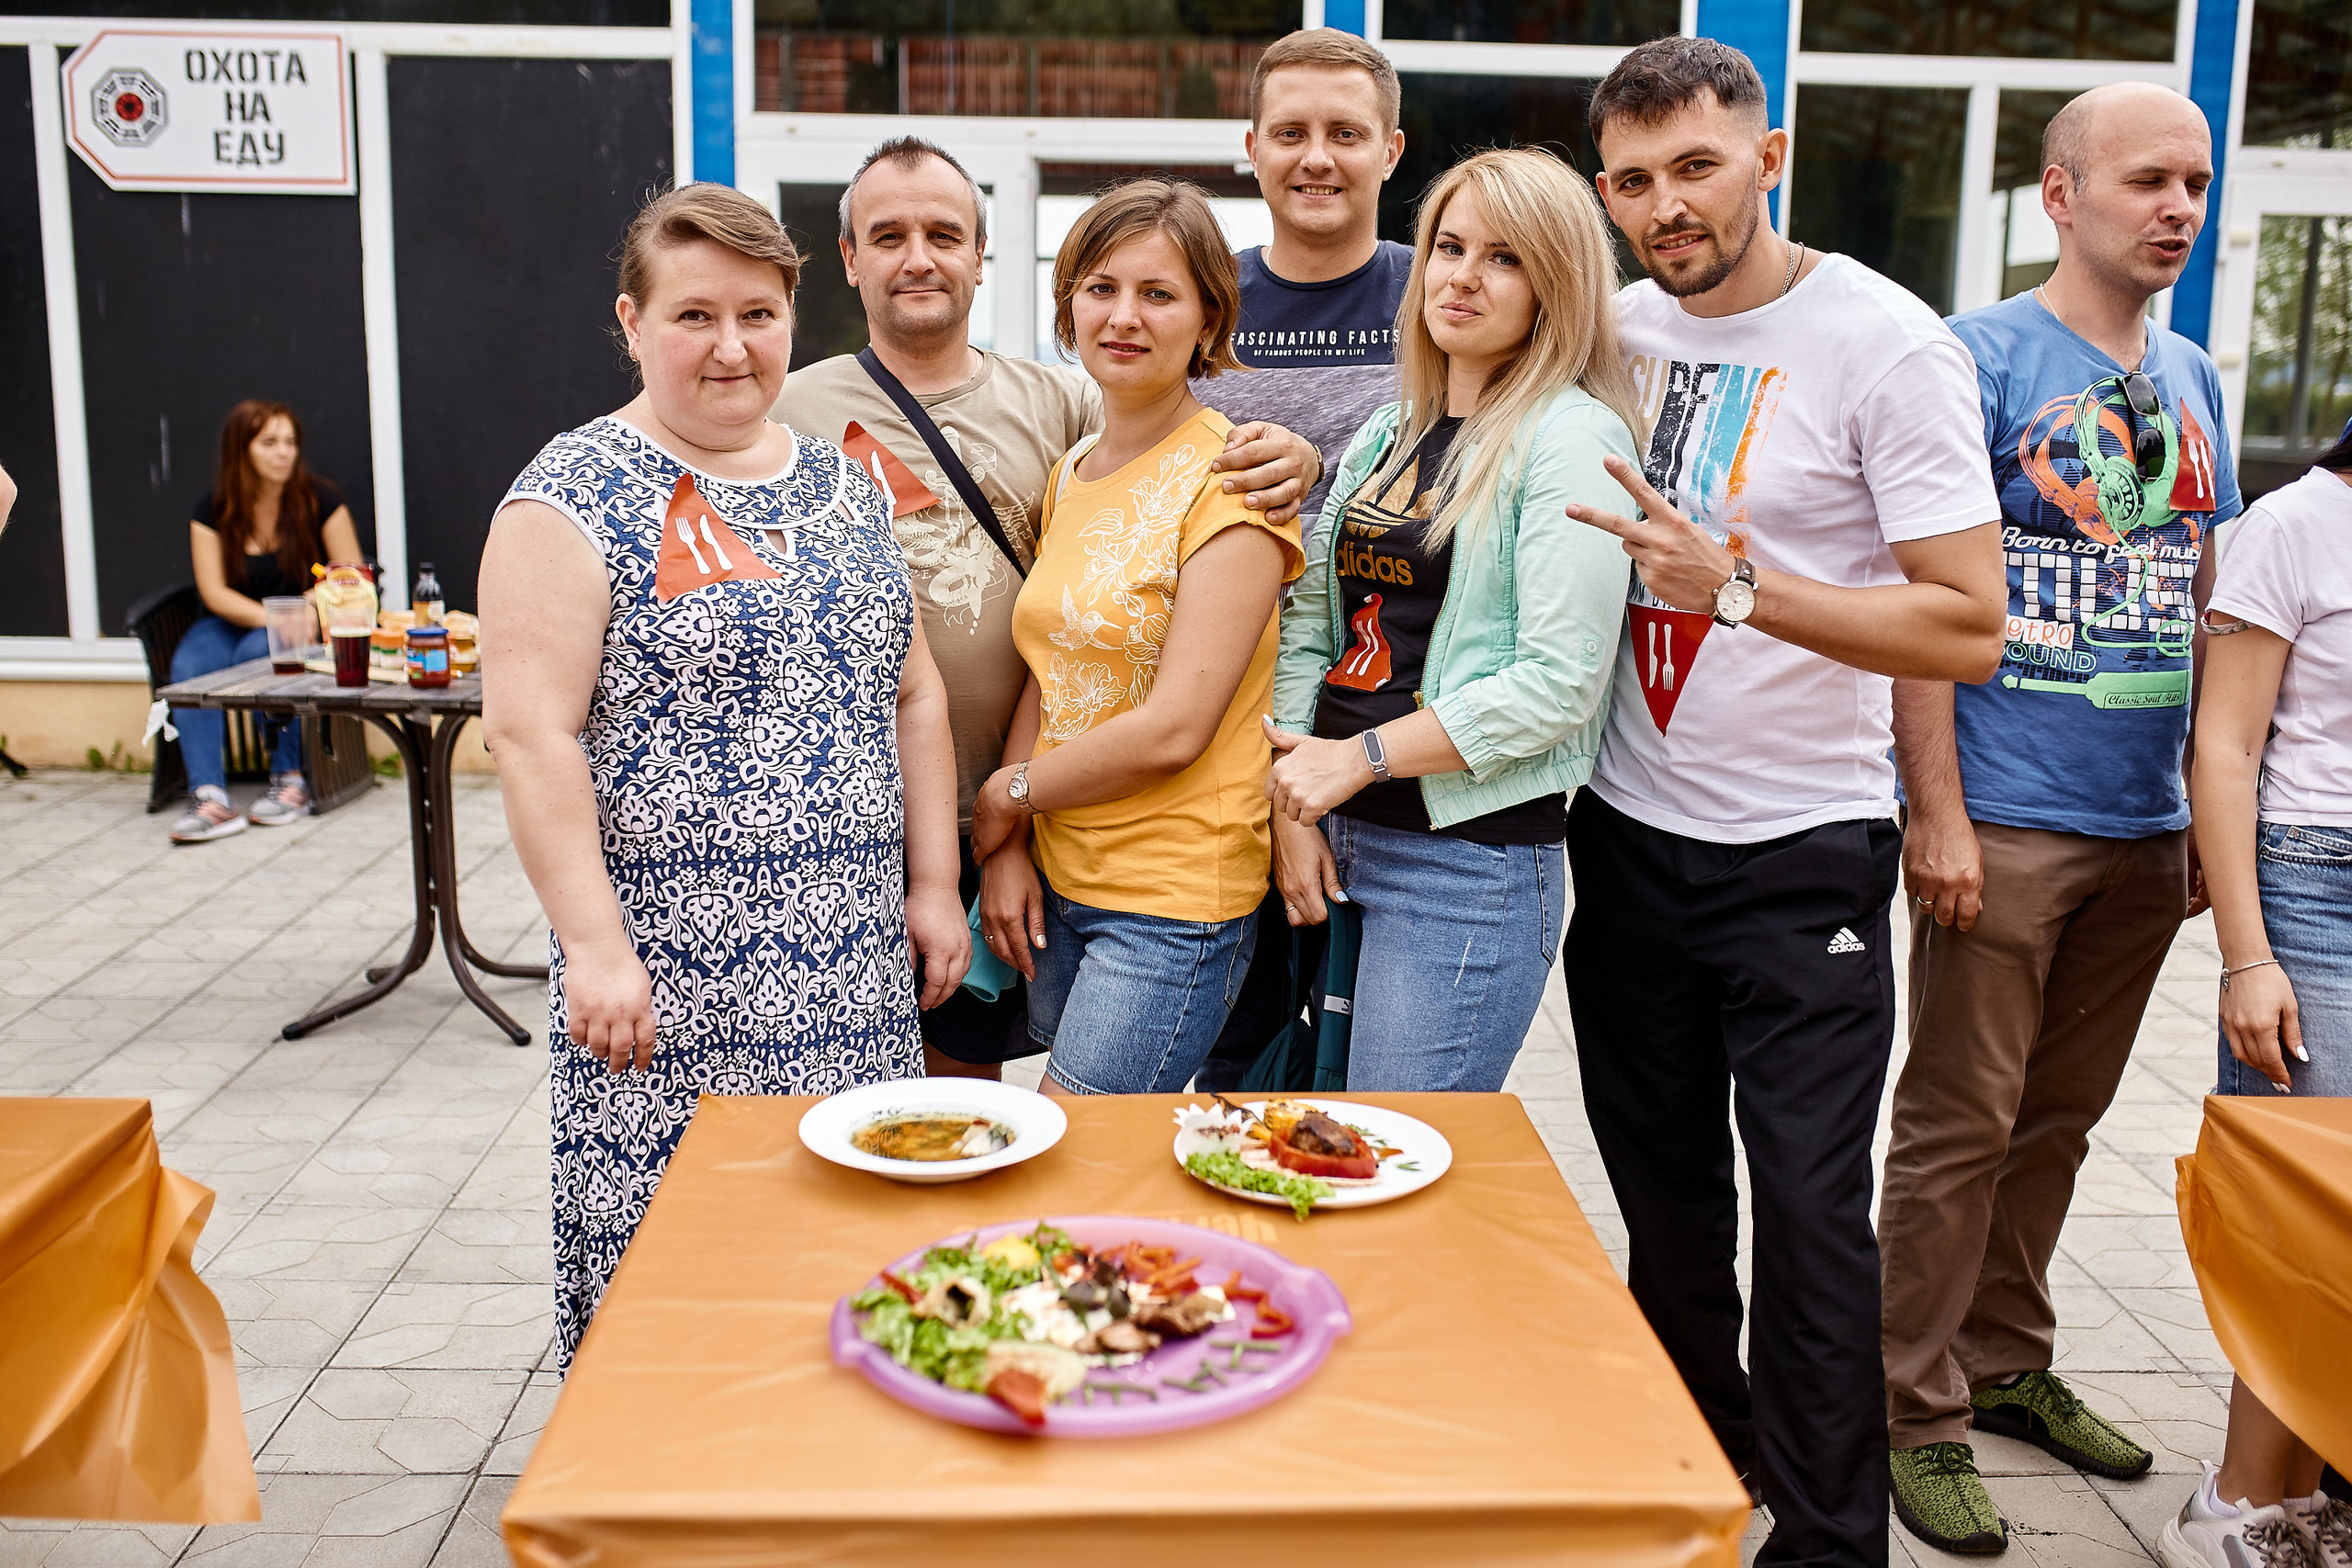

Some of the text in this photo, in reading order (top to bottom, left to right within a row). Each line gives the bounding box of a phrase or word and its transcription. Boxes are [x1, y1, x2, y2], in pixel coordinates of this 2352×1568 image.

[186, 50, 306, 84] ОХОТА
[225, 91, 271, 123] НА
[214, 130, 285, 167] ЕДУ
[1348, 330, 1399, 345] FACTS
[2002, 526, 2070, 551] Born
[2071, 539, 2106, 555] to
[1336, 540, 1413, 585] didas
[2007, 618, 2072, 646] etRO
[2002, 641, 2097, 672] OUND
[2108, 693, 2180, 705] Classic Soul Hits
[1827, 942, 1865, 953] adidas
